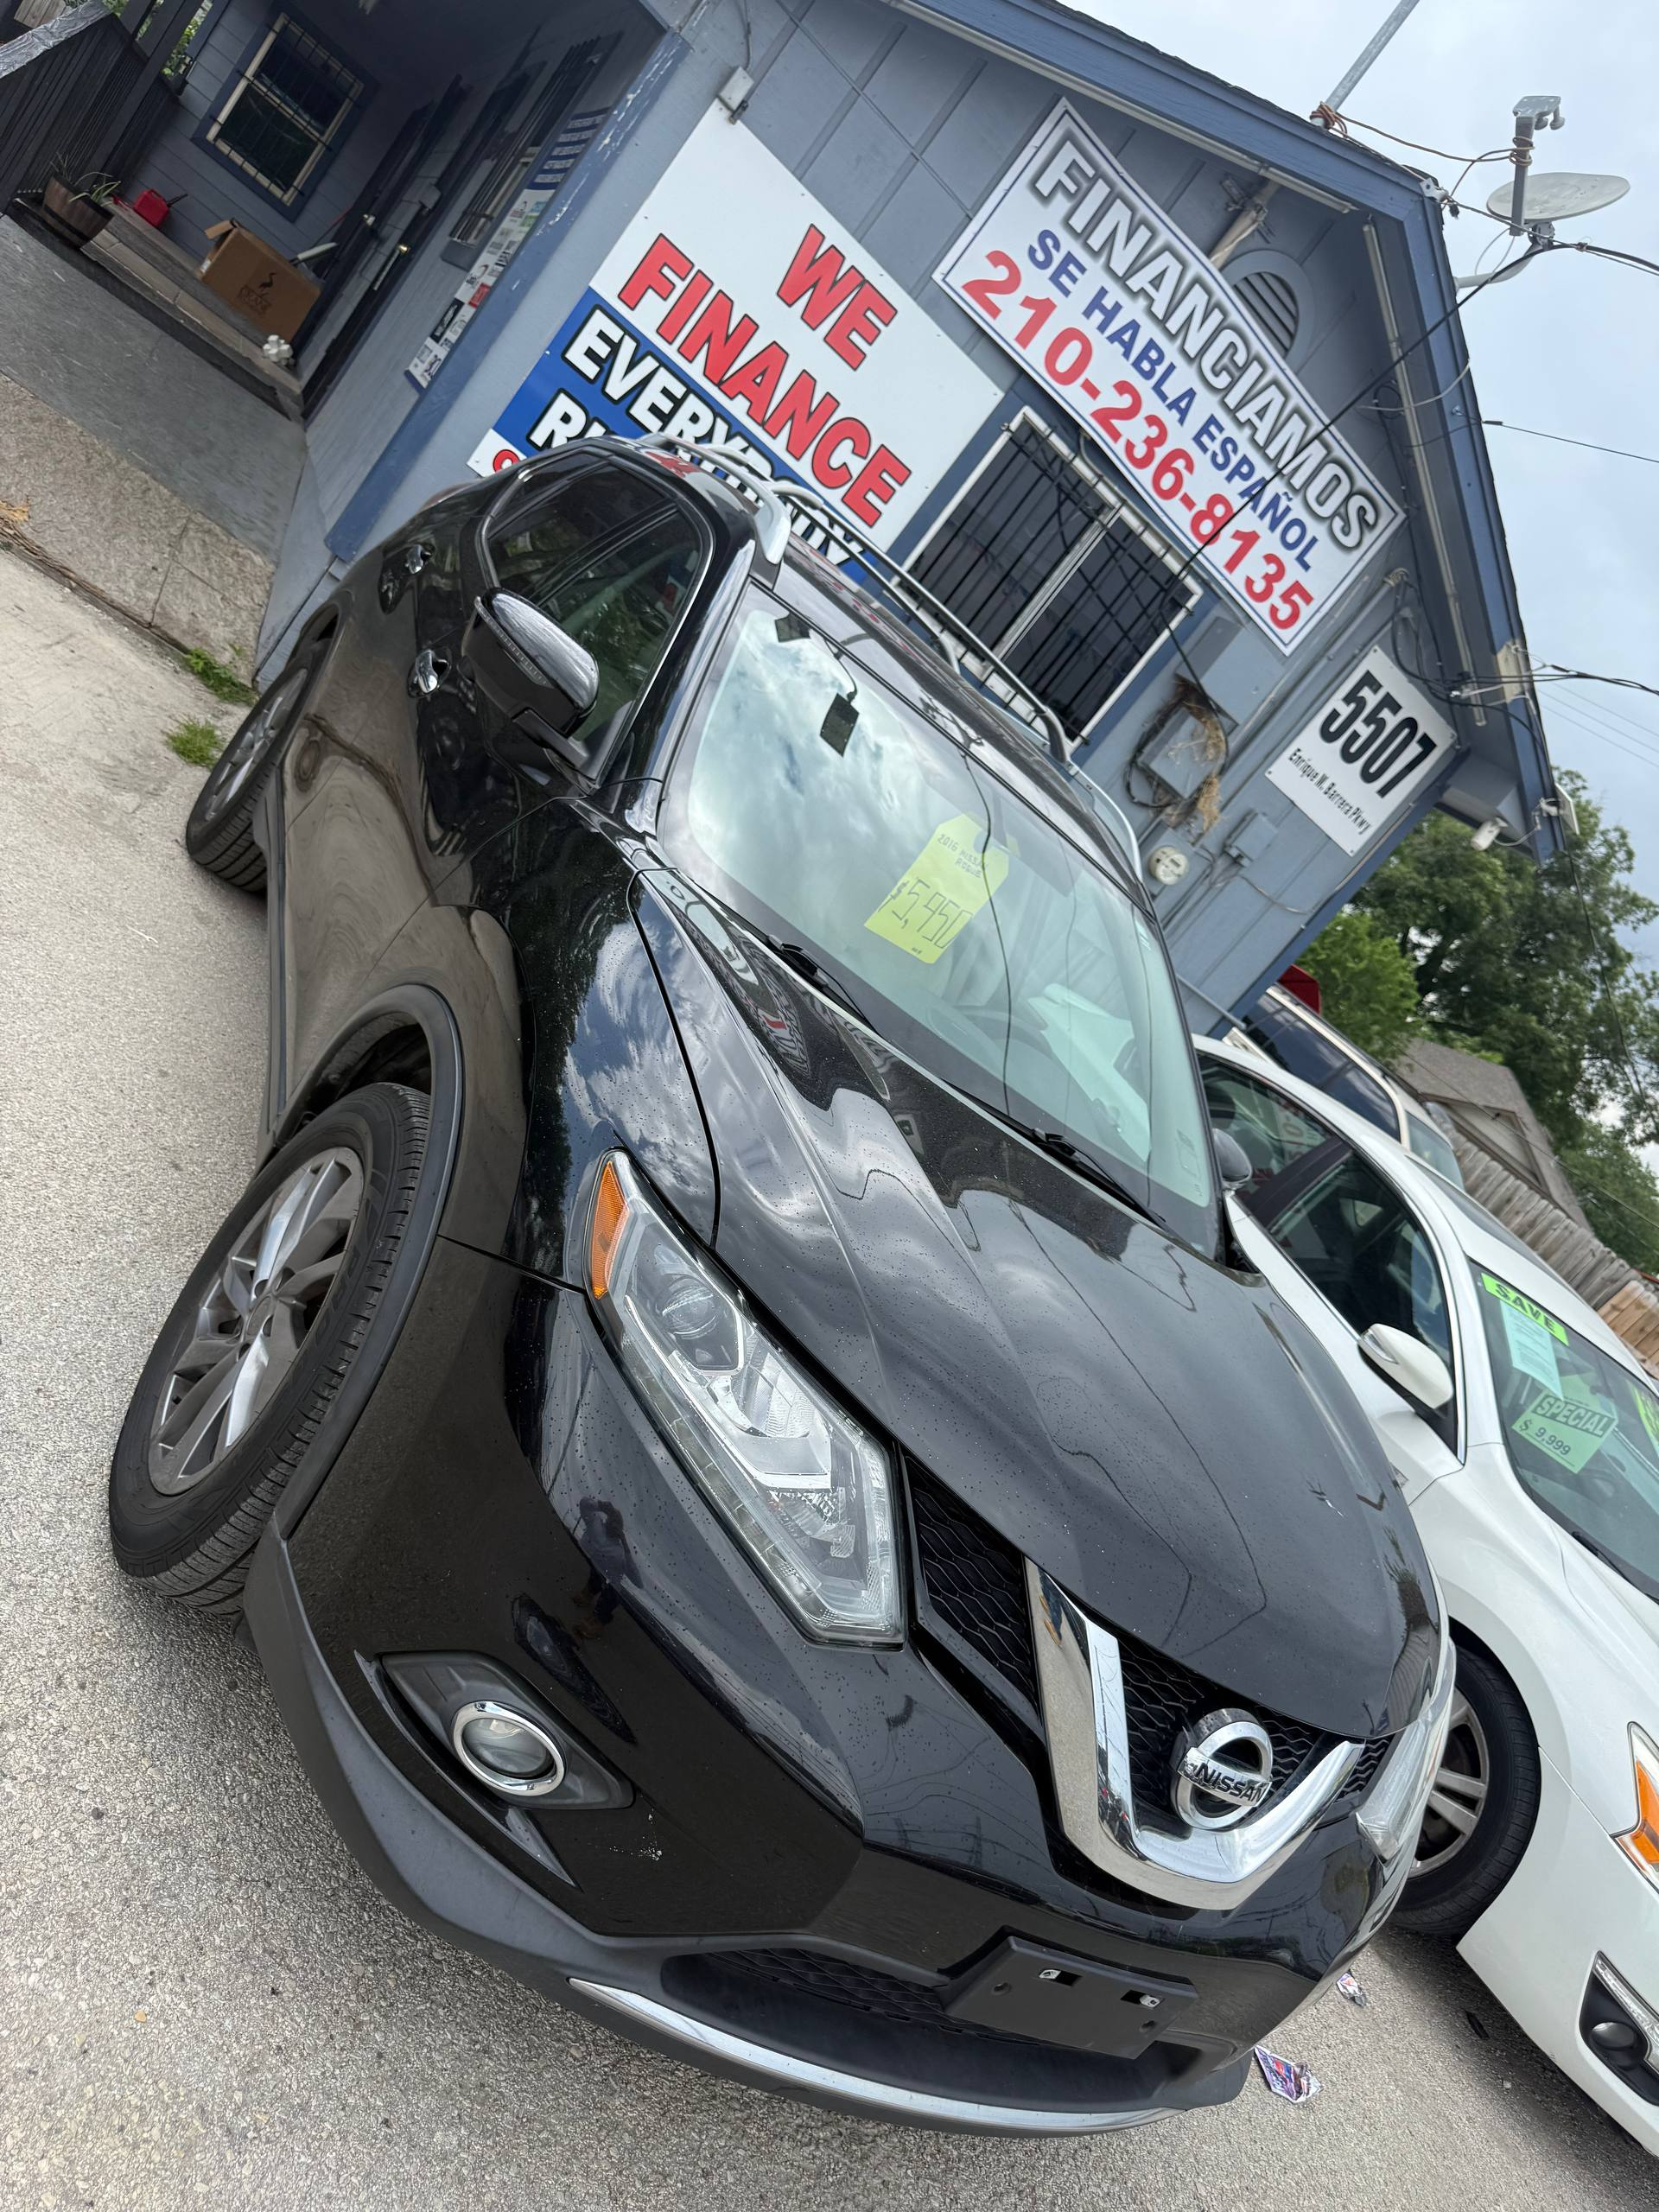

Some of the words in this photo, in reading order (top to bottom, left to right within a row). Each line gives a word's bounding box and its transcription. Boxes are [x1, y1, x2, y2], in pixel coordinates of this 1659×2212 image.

[777, 224, 898, 371] WE
[1032, 138, 1379, 552] FINANCIAMOS
[618, 233, 912, 527] FINANCE
[962, 250, 1314, 631] 210-236-8135
[1027, 229, 1087, 297] SE
[1081, 287, 1198, 426] HABLA
[1192, 414, 1325, 572] ESPAÑOL
[1287, 747, 1319, 782] Enrique
[1323, 782, 1353, 816] Barrera
[1319, 670, 1437, 798] 5507
[937, 833, 960, 853] 2016
[1495, 1282, 1557, 1332] SAVE
[1535, 1395, 1610, 1438] SPECIAL
[1196, 1761, 1268, 1802] NISSAN
